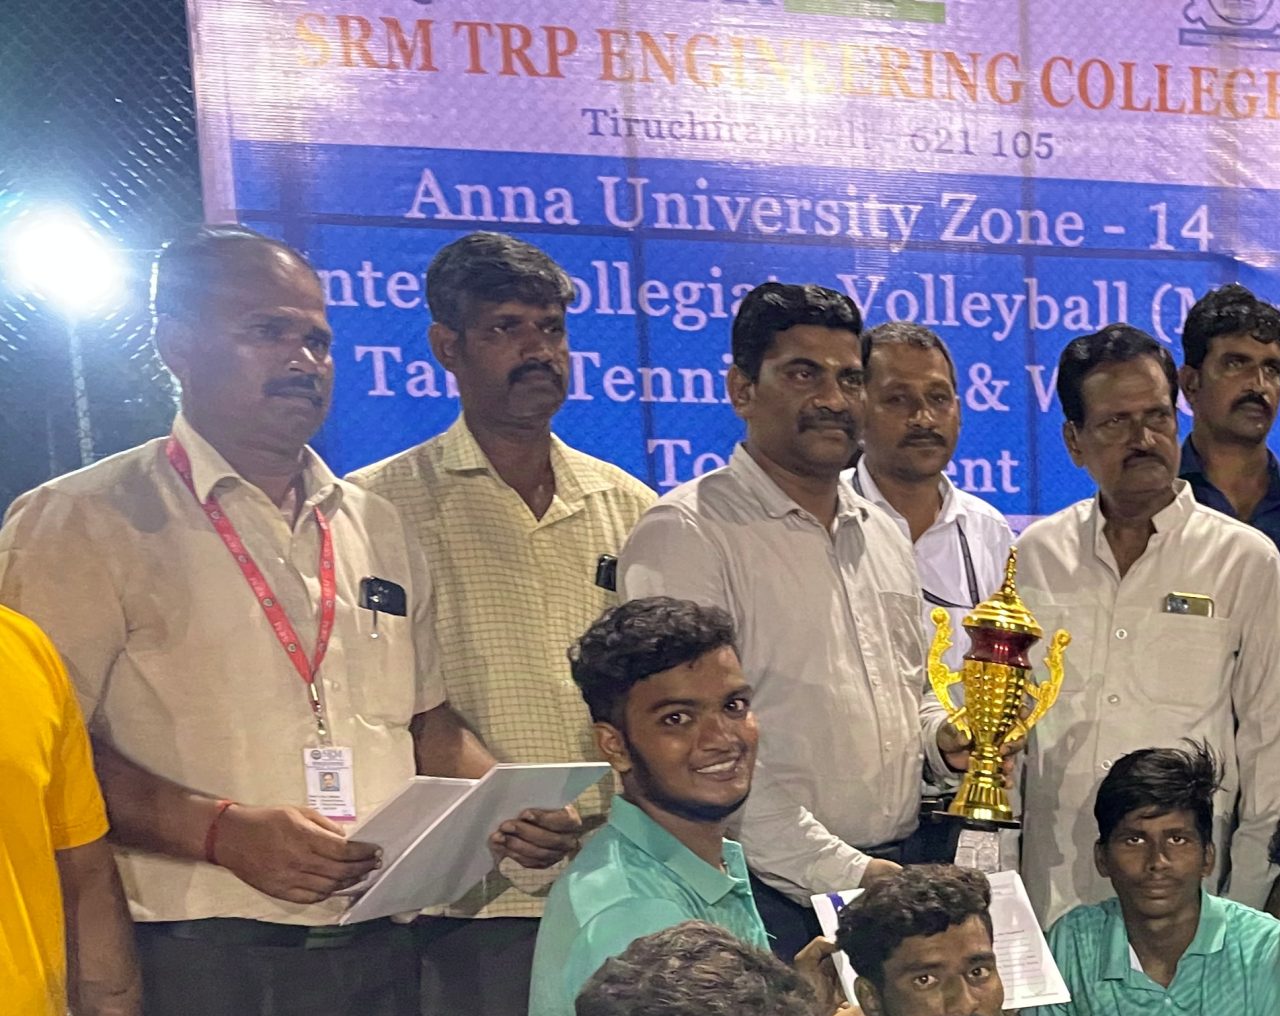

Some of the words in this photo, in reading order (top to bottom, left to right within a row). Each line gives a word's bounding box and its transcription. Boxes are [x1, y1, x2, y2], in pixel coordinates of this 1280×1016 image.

[295, 13, 440, 73] SRM
[453, 21, 578, 79] TRP
[596, 28, 1025, 106] ENGINEERING
[909, 127, 977, 156] 621
[990, 129, 1056, 160] 105
[404, 168, 580, 225] Anna
[597, 176, 922, 251] University
[940, 193, 1084, 247] Zone
[1104, 226, 1125, 234] -
[1149, 204, 1214, 251] 14
[316, 261, 428, 309] nte
[836, 273, 1127, 341] Volleyball
[965, 362, 1010, 411] &
